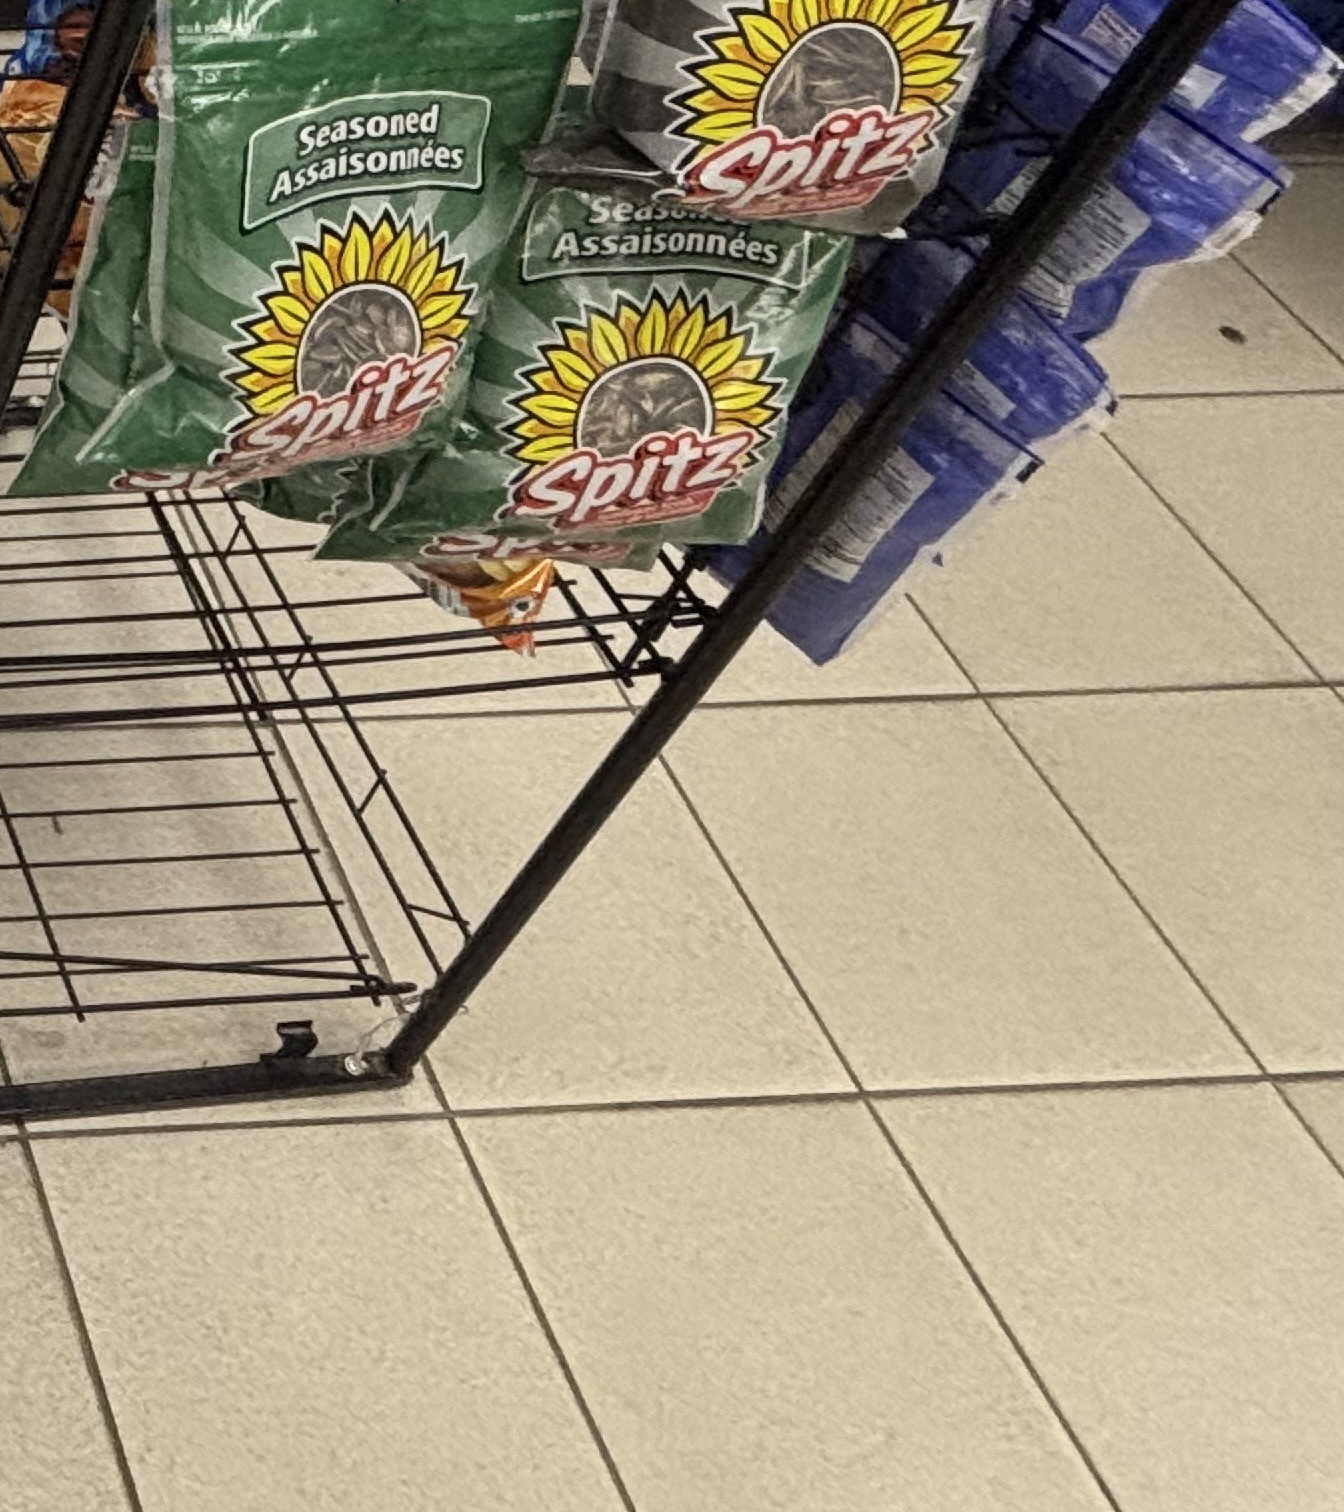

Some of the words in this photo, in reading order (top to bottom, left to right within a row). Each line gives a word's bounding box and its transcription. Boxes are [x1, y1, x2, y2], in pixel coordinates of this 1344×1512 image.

[299, 105, 439, 156] Seasoned
[699, 112, 927, 207] Spitz
[269, 141, 464, 203] Assaisonnées
[552, 227, 779, 264] Assaisonnées
[241, 349, 453, 458] Spitz
[521, 433, 745, 521] Spitz
